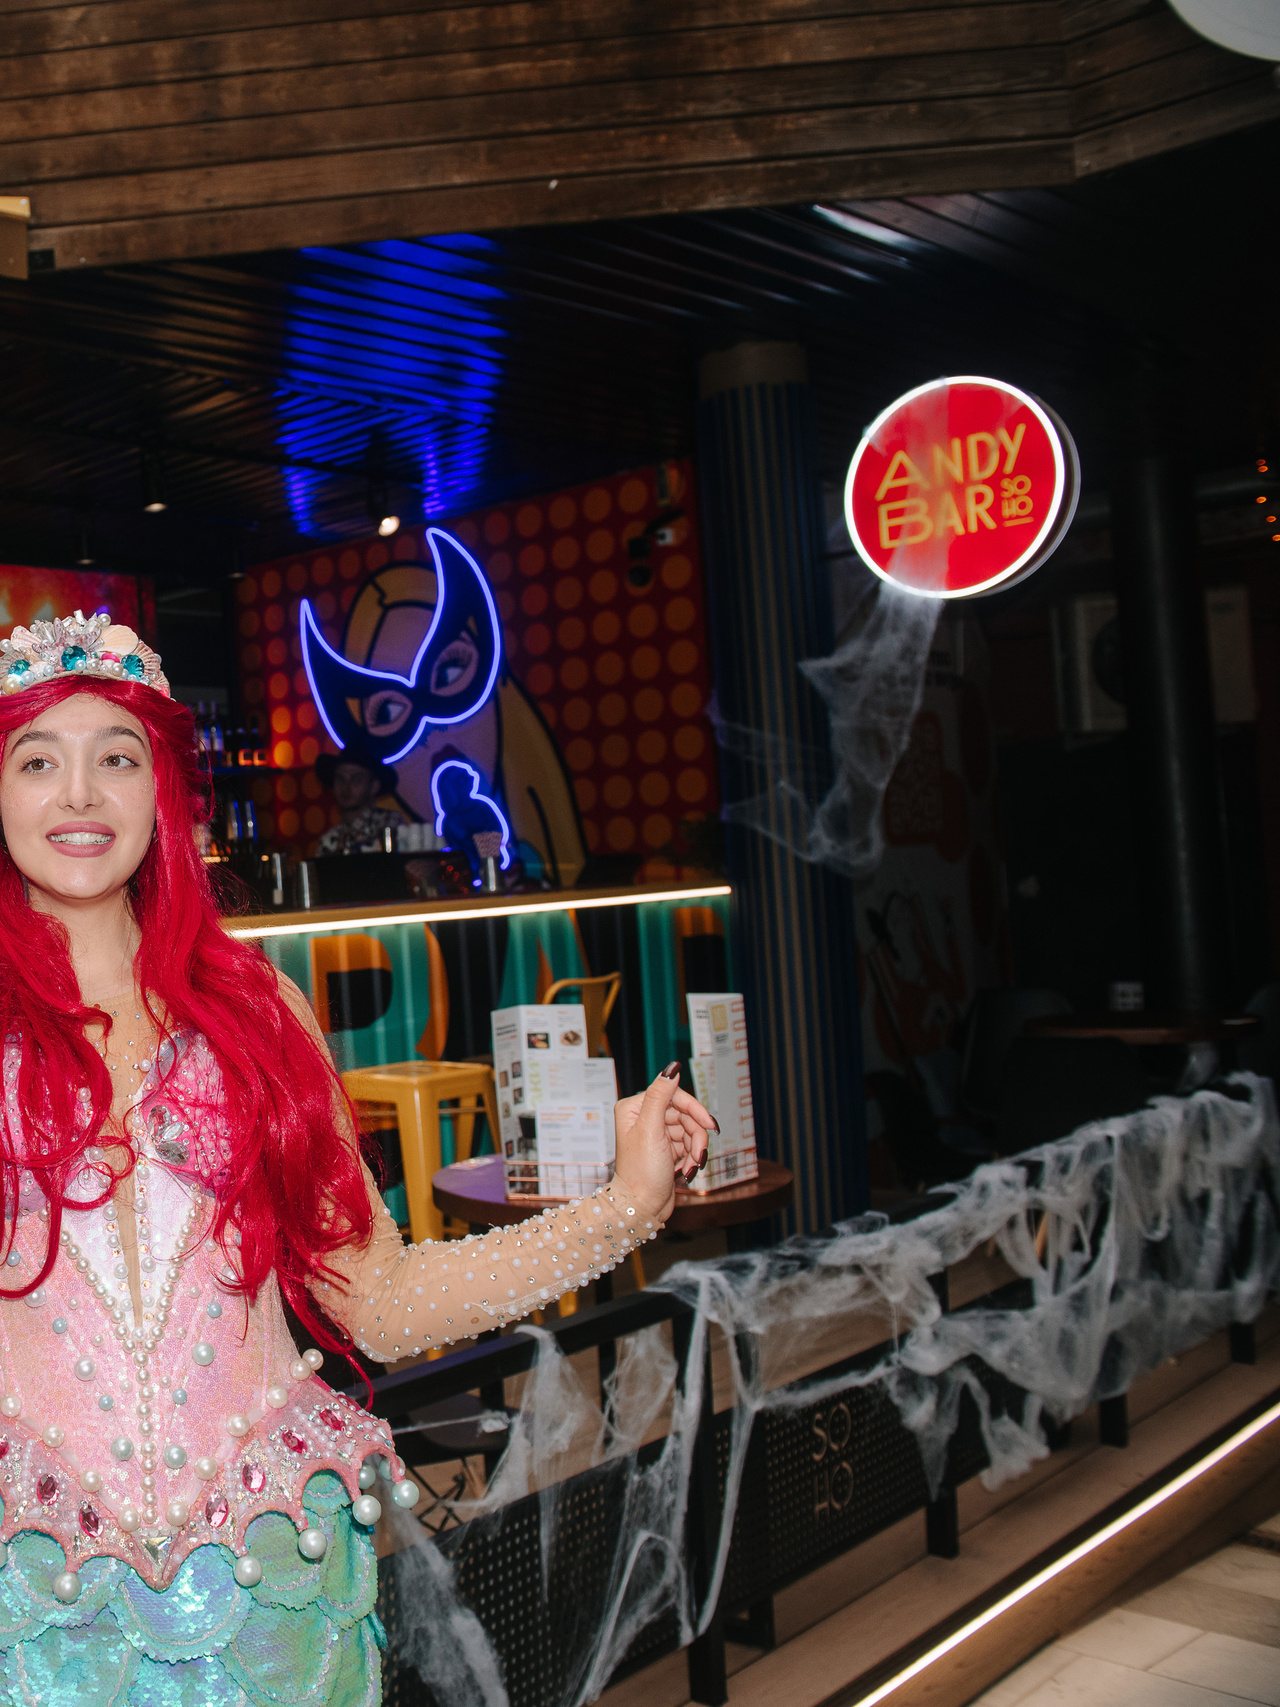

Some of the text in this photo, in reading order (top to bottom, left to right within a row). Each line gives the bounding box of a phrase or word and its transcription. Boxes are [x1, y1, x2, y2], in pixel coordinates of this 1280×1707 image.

[874, 422, 1027, 502] ANDY
[999, 474, 1032, 498] SO
[877, 483, 998, 550] BAR
[1001, 495, 1034, 519] HO
[811, 1401, 852, 1462] SO
[813, 1460, 855, 1521] HO
